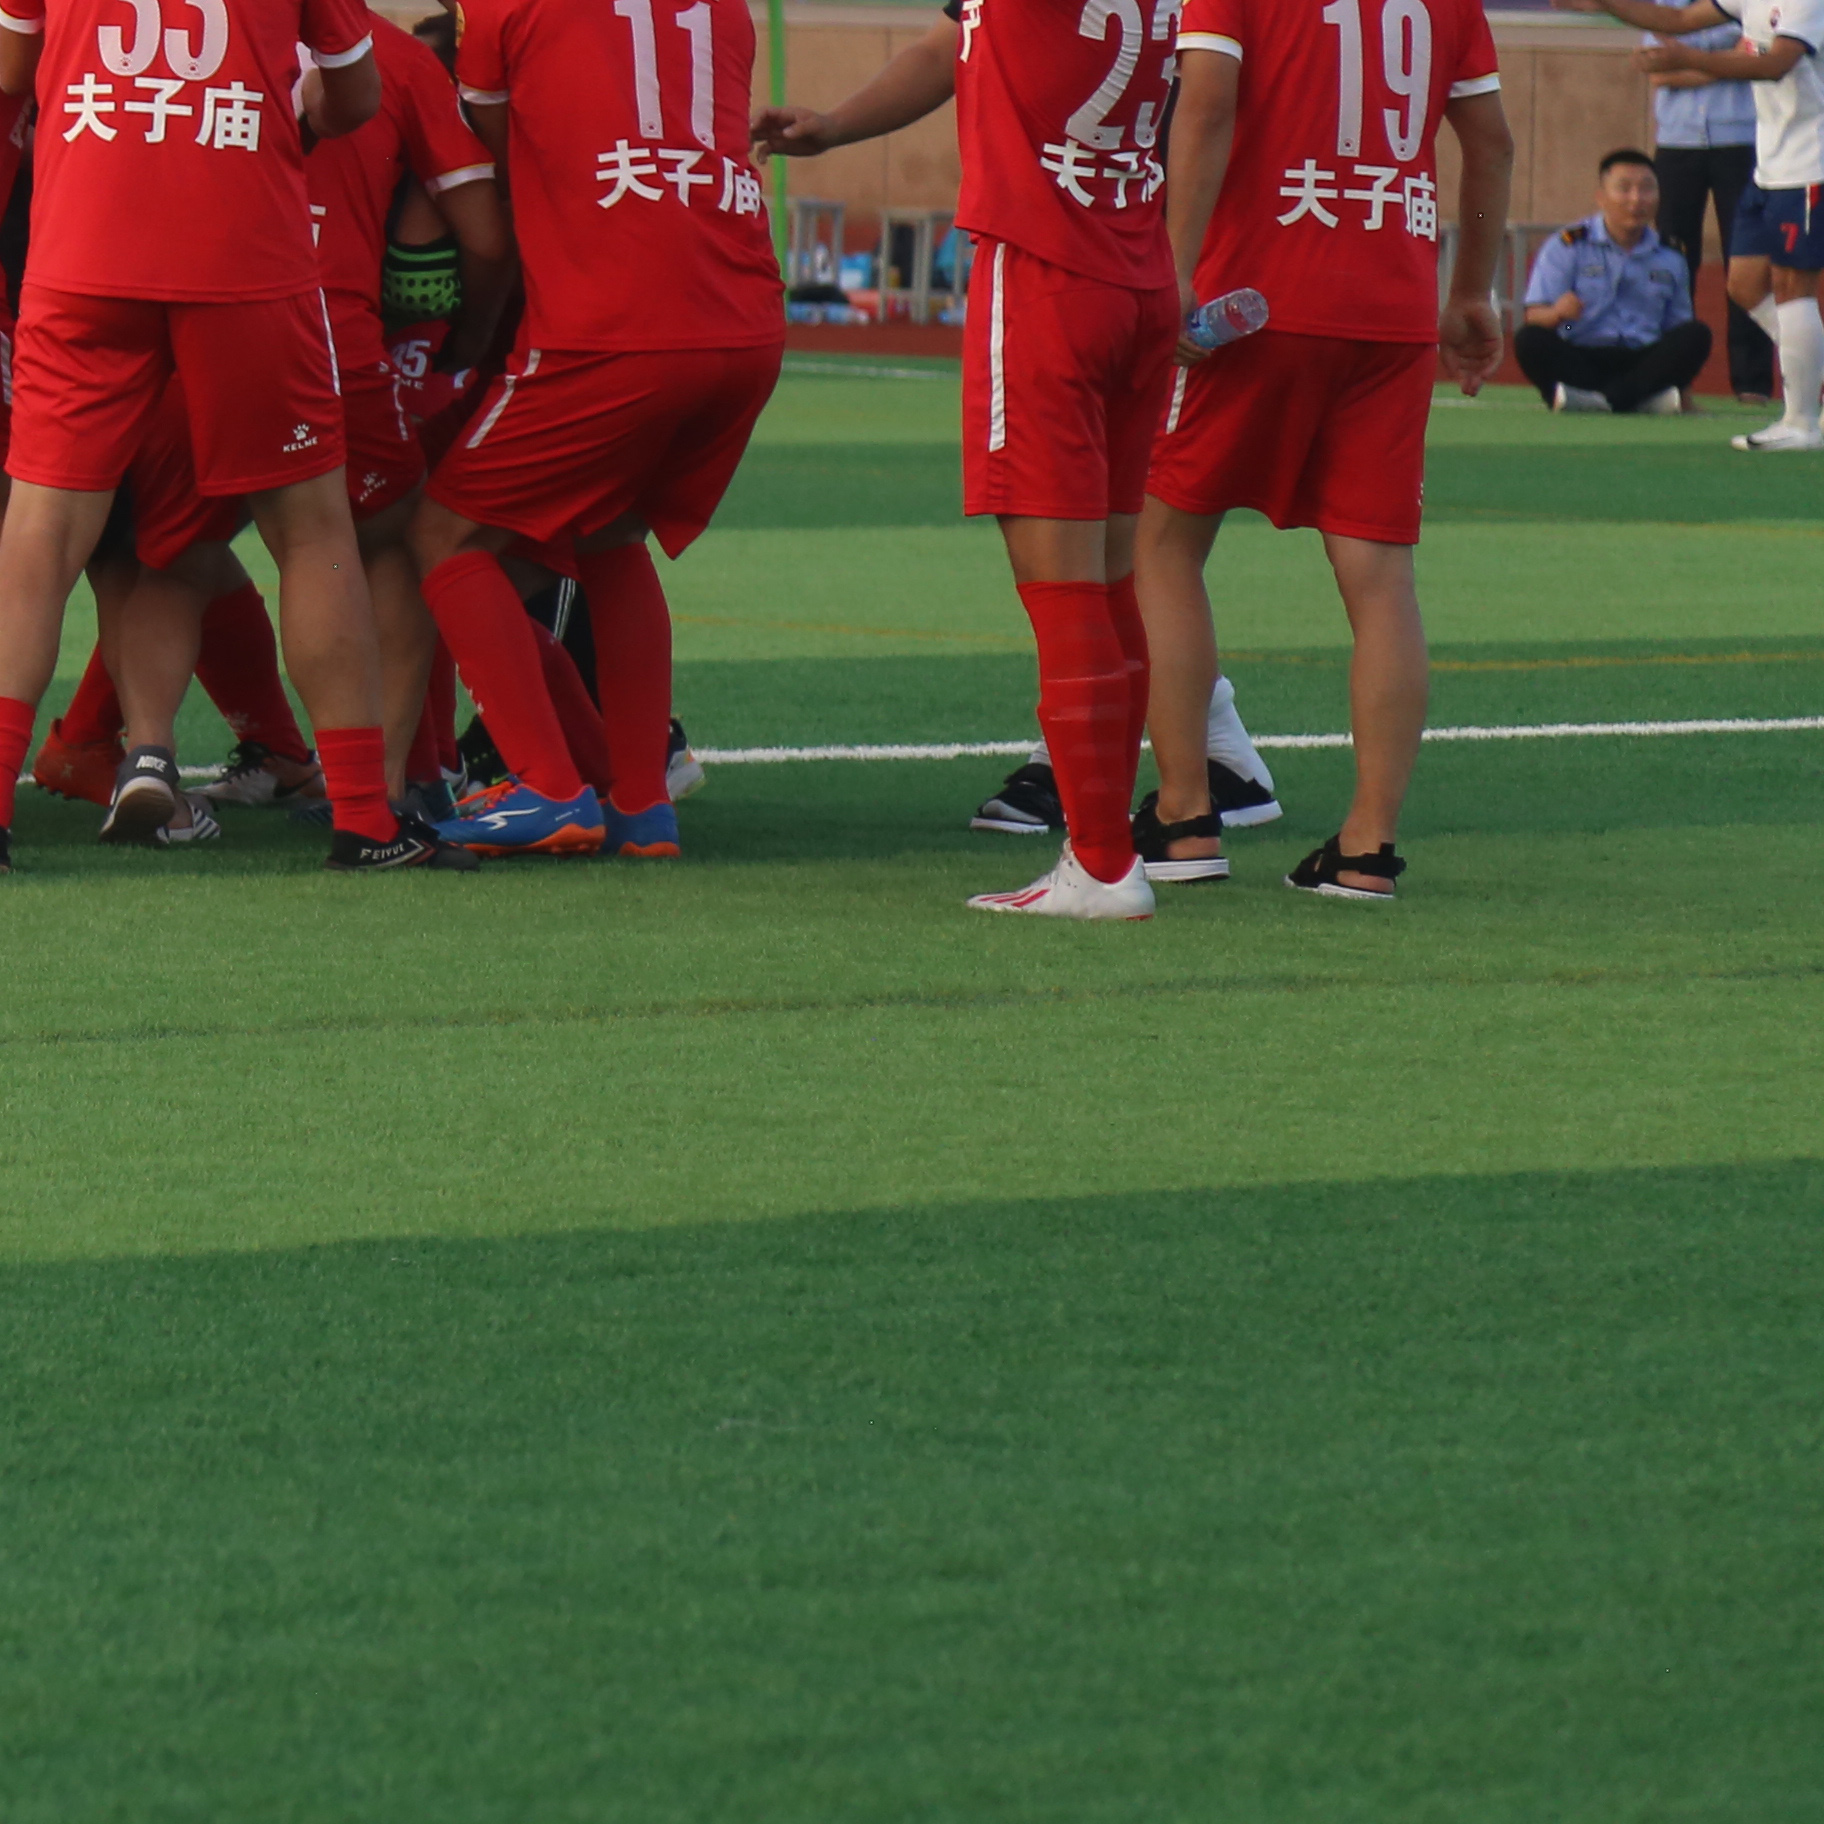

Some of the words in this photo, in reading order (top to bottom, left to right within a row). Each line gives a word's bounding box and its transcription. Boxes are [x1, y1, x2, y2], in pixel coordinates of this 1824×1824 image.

[62, 73, 264, 152] 夫子庙
[595, 139, 763, 218] 夫子庙
[1276, 159, 1437, 243] 夫子庙
[283, 436, 318, 453] KELME
